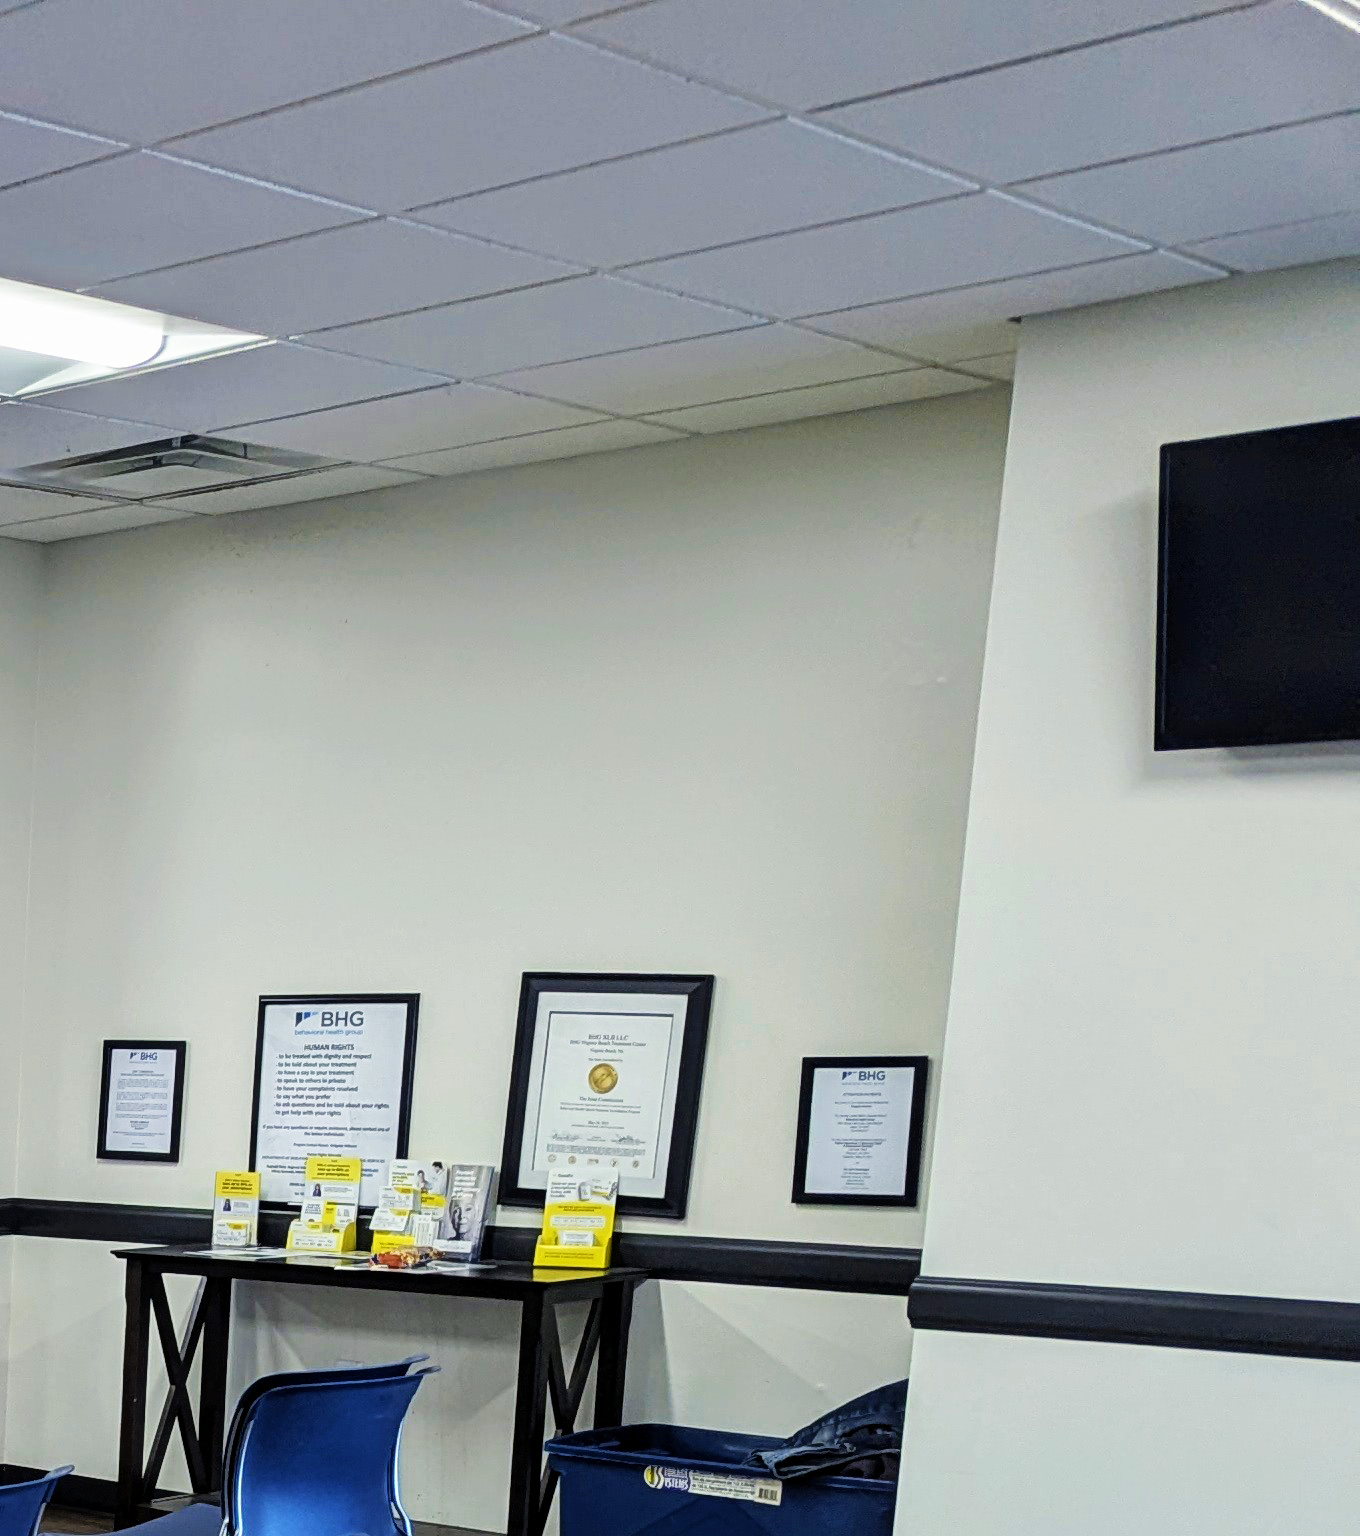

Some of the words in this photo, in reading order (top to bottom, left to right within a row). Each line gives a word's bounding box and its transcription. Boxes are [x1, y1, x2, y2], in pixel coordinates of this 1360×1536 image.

[321, 1011, 364, 1027] BHG
[140, 1052, 158, 1060] BHG
[858, 1070, 886, 1081] BHG
